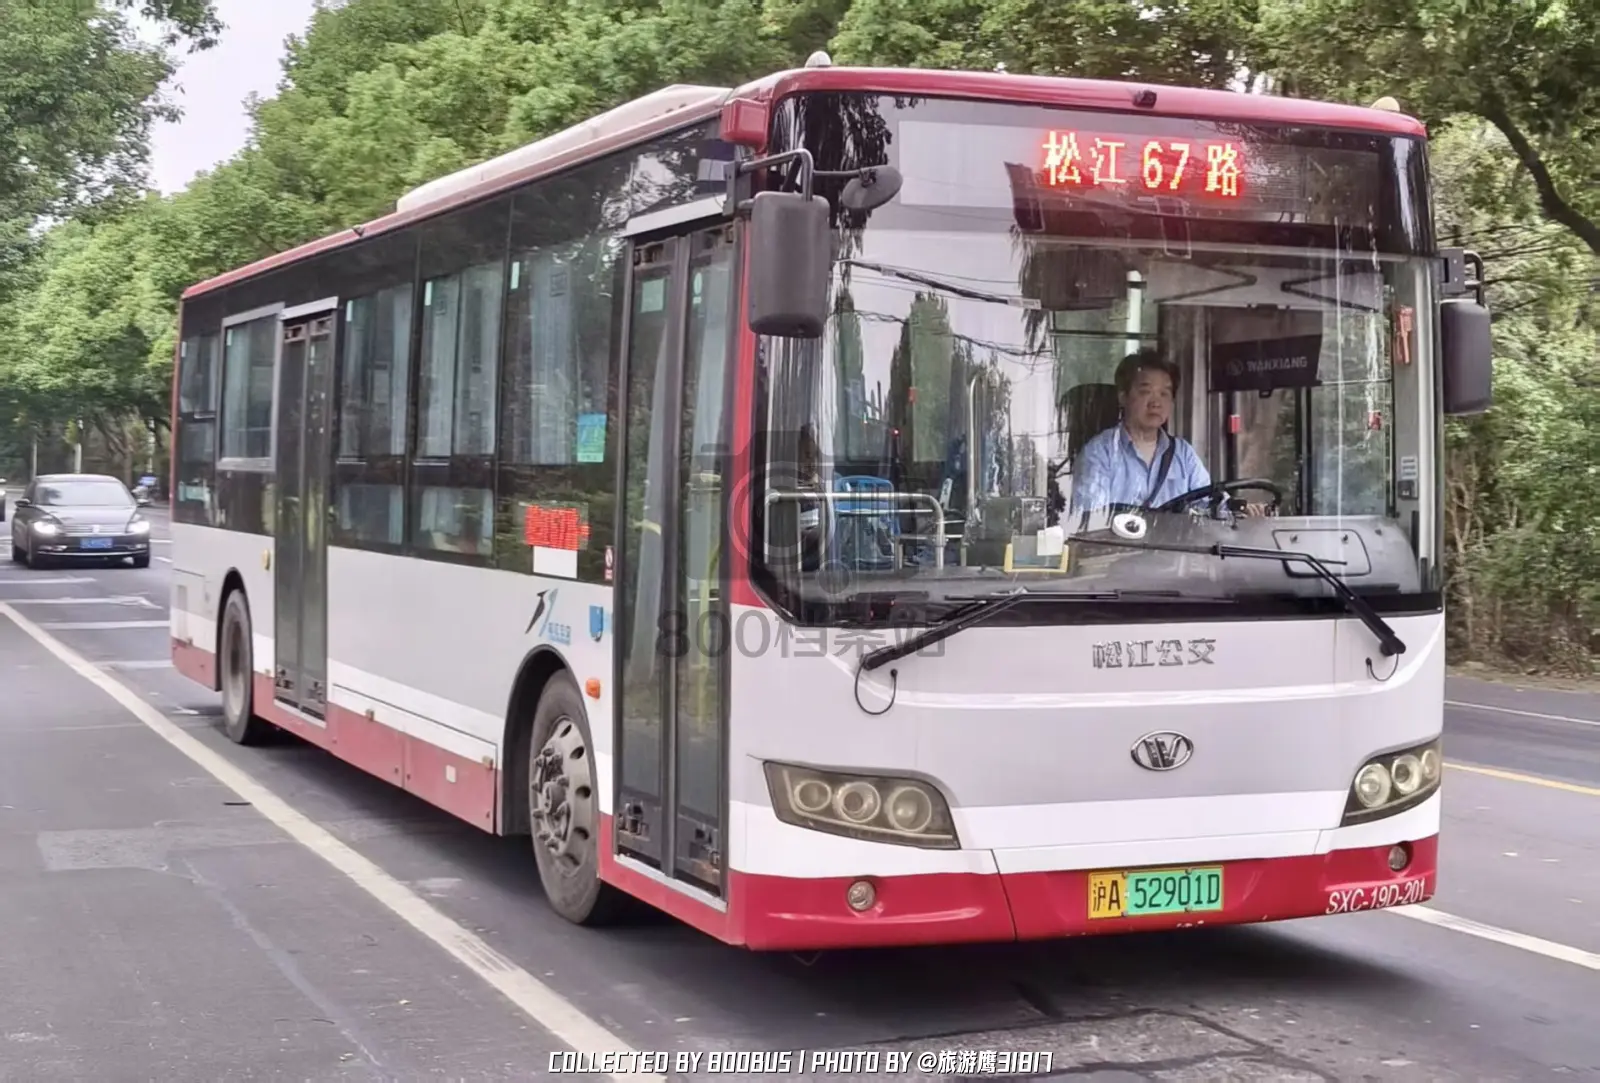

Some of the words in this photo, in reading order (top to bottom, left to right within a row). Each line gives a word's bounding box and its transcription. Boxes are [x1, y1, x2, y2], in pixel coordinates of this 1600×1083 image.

[1042, 130, 1241, 196] 松江67路
[1092, 638, 1217, 669] 松江公交
[1325, 877, 1426, 915] SXC-19D-201
